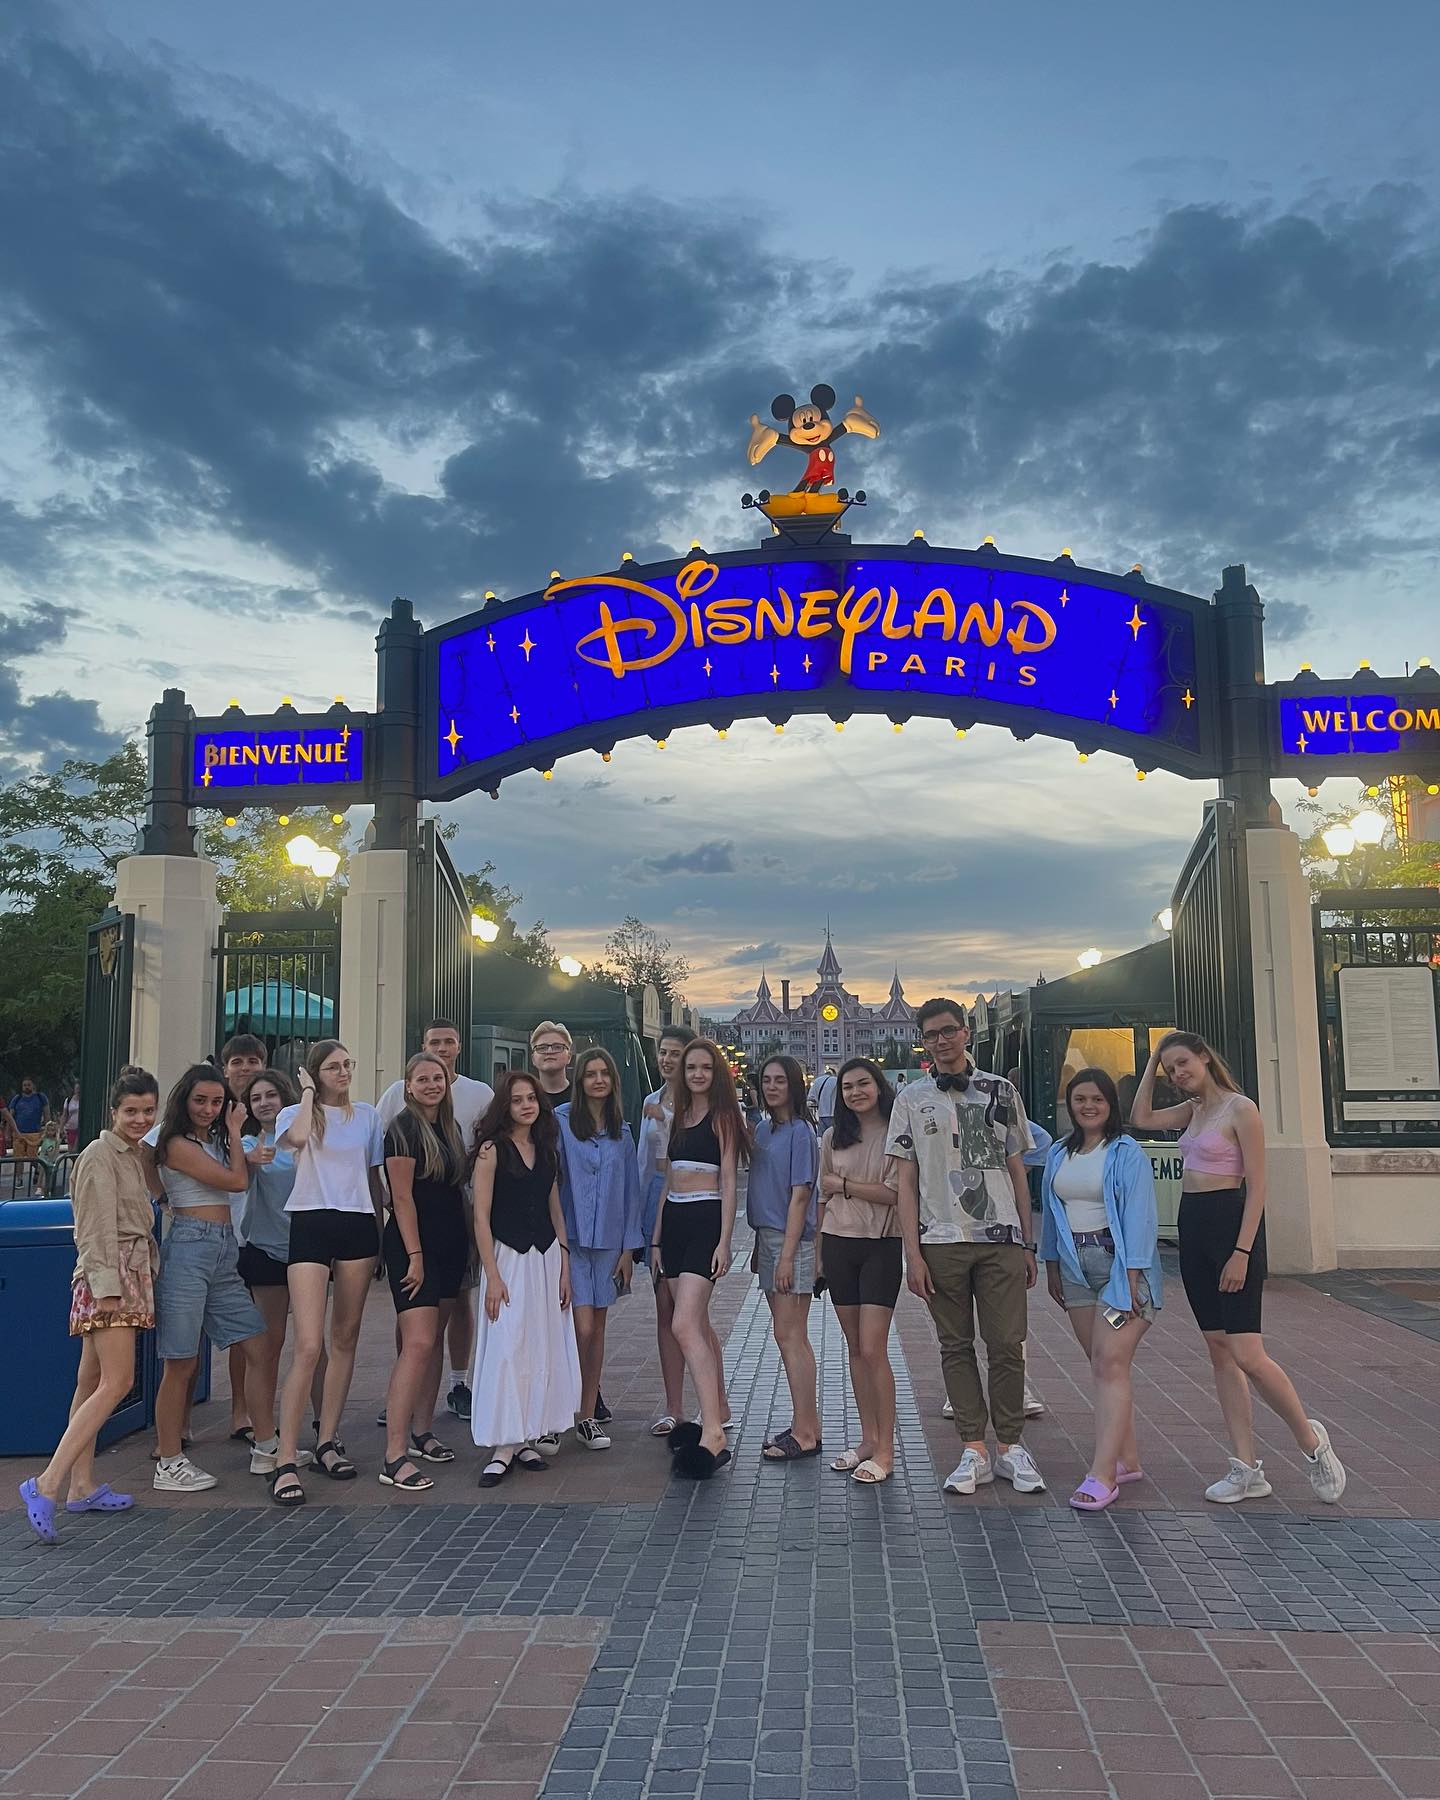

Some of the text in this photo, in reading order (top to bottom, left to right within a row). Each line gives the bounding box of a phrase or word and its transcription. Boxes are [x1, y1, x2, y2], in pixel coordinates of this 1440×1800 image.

[868, 652, 1037, 686] PARIS
[1302, 708, 1440, 732] WELCOM
[205, 741, 348, 766] BIENVENUE
